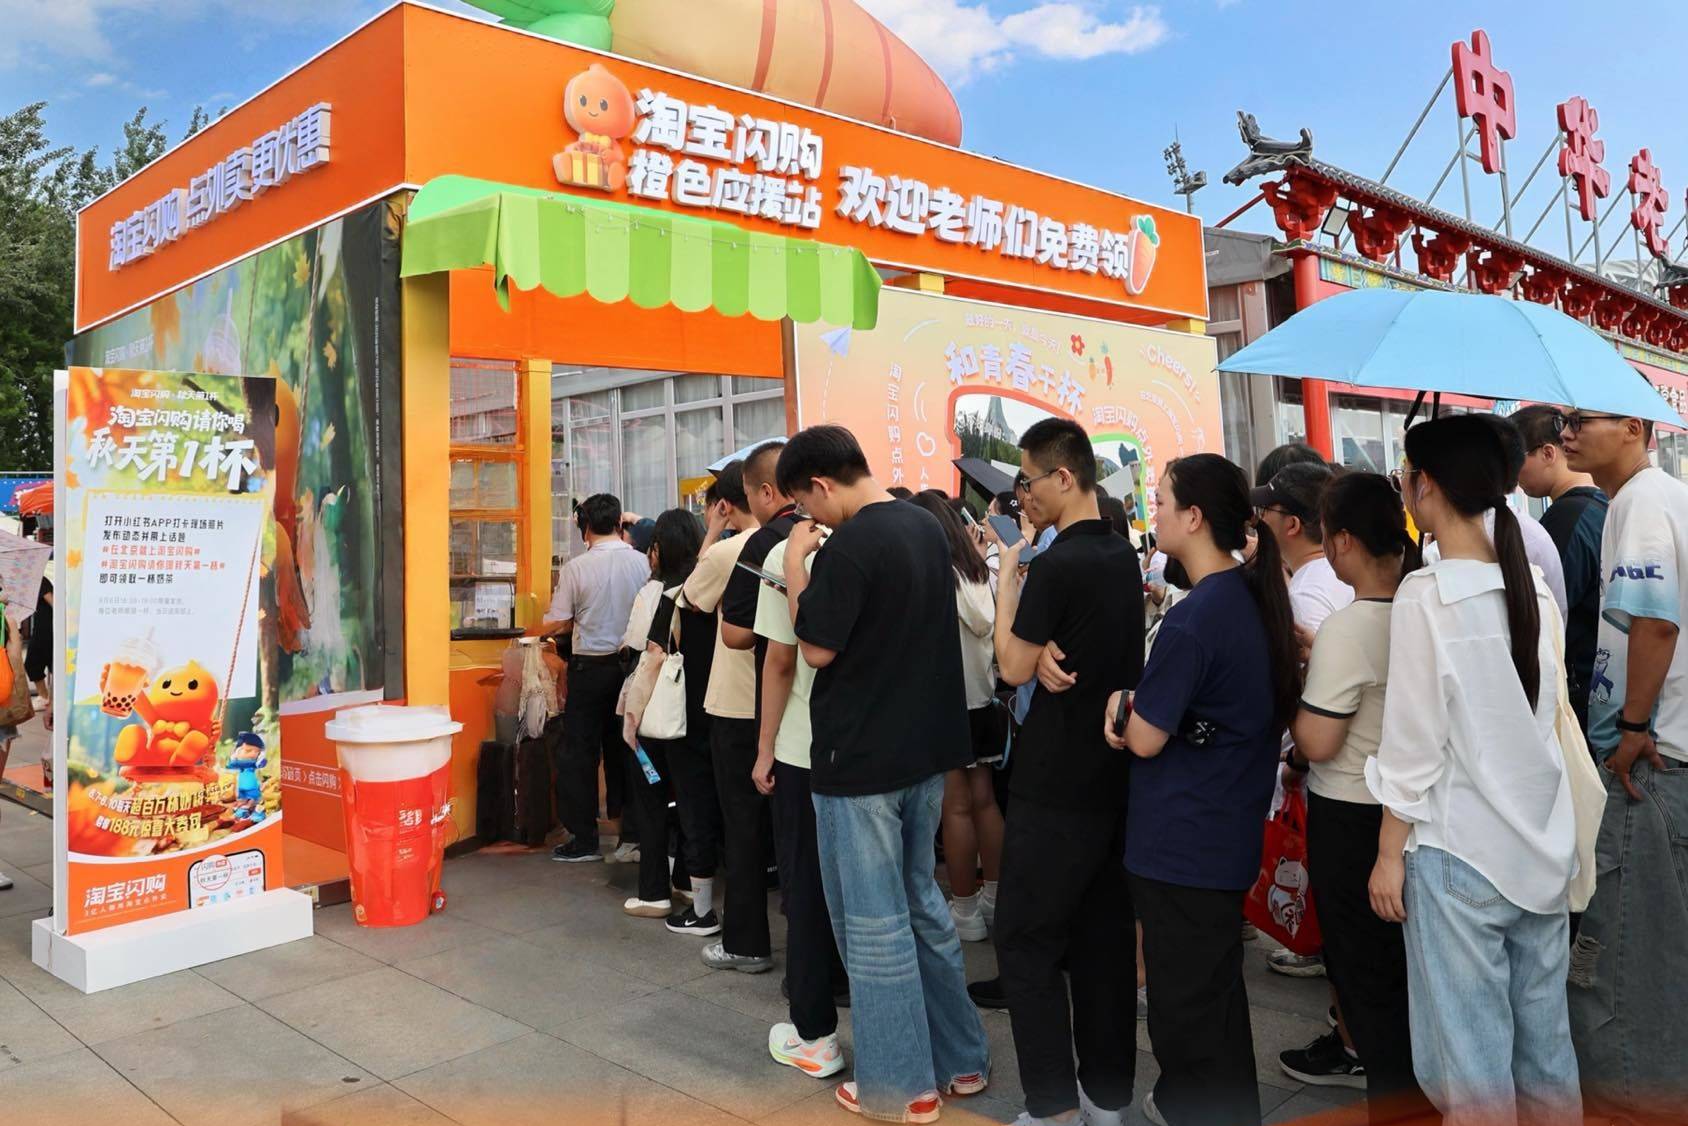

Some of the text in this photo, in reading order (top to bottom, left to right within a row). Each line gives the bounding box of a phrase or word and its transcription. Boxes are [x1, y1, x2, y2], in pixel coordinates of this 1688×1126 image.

[634, 88, 823, 179] 淘宝闪购
[108, 102, 332, 272] 淘宝闪购 点外卖更优惠
[626, 149, 1131, 280] 橙色应援站 欢迎老师们免费领
[944, 341, 1086, 415] 和青春干杯
[108, 405, 246, 435] 淘宝闪购请你喝
[87, 427, 258, 491] 秋天第1杯
[84, 873, 167, 908] 淘宝闪购
